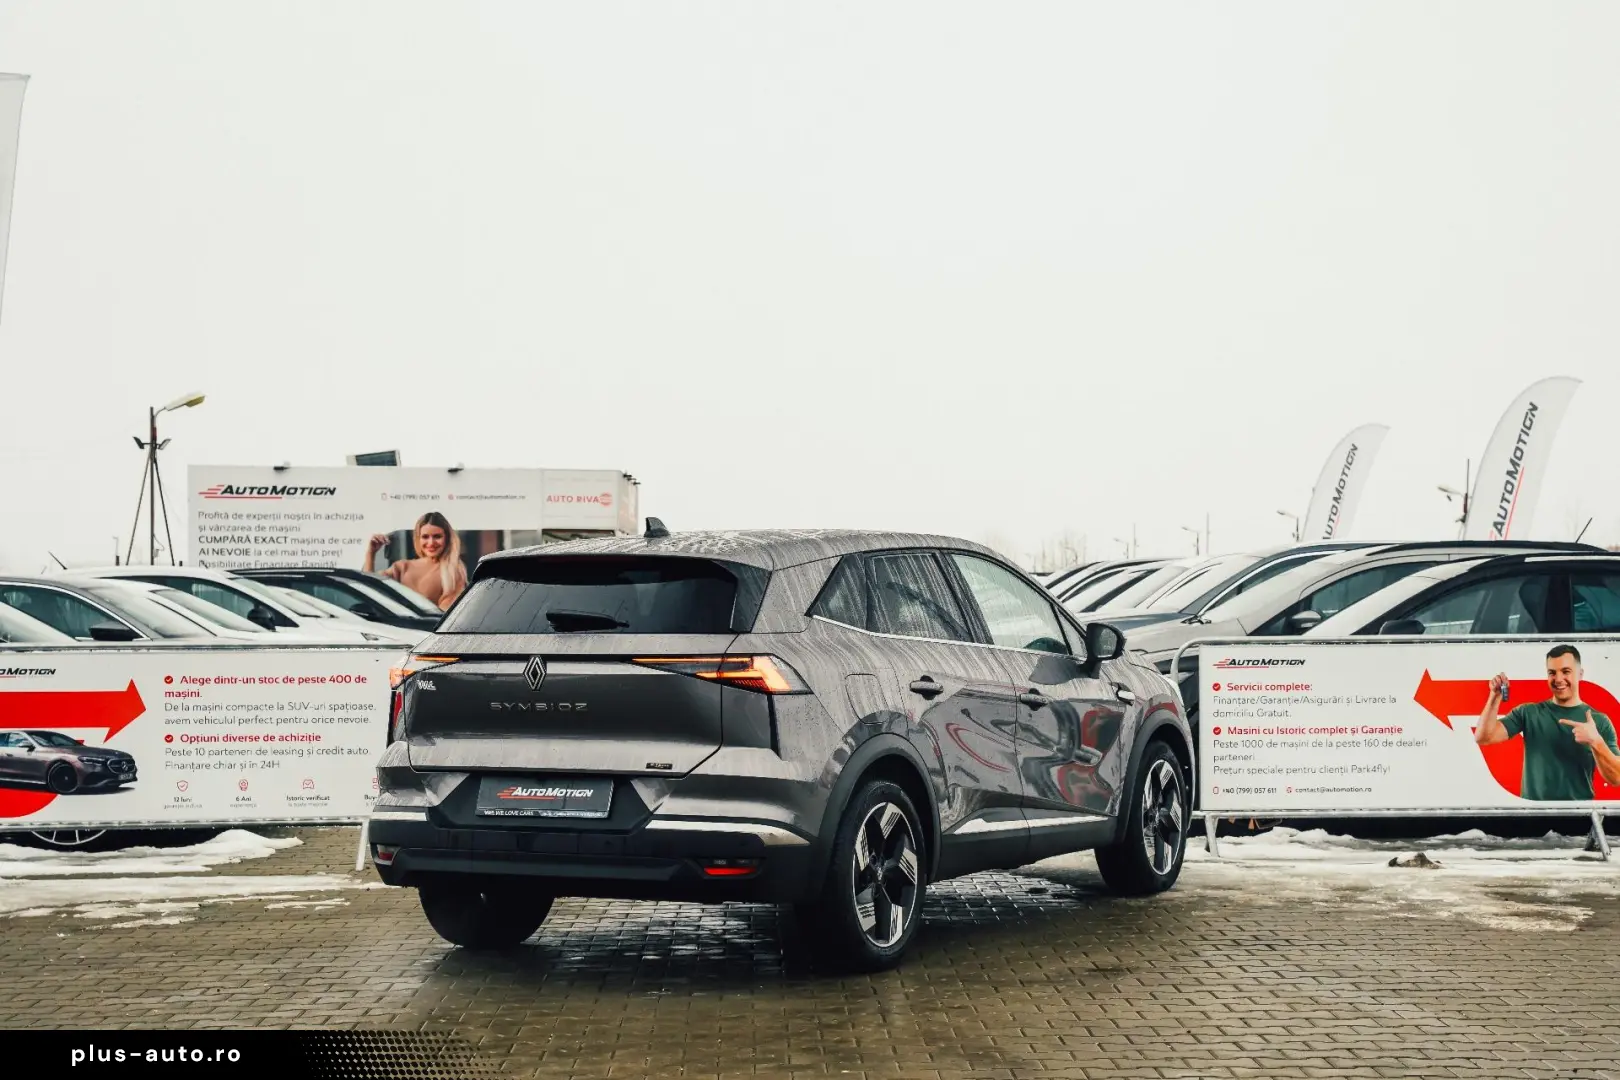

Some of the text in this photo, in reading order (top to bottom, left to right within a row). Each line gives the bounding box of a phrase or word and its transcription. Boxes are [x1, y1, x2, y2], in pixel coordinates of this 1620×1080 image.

[232, 512, 244, 520] de
[254, 524, 267, 532] de
[254, 536, 288, 544] EXACT
[199, 548, 209, 556] AI
[212, 548, 250, 556] NEVOIE
[265, 548, 279, 556] cel
[301, 548, 319, 556] bun
[180, 675, 367, 686] Alege dintr-un stoc de peste 400 de
[1227, 683, 1312, 692] Servicii complete:
[1356, 695, 1386, 703] Livrare
[1389, 695, 1396, 703] la
[165, 702, 178, 711] De
[182, 702, 189, 711] la
[193, 703, 222, 714] mașini
[226, 704, 274, 712] compacte
[277, 702, 284, 711] la
[288, 702, 325, 710] SUV-uri
[1213, 709, 1253, 717] domiciliu
[193, 716, 235, 724] vehiculul
[237, 715, 273, 726] perfect
[276, 716, 308, 726] pentru
[311, 715, 334, 723] orice
[1277, 726, 1306, 734] Istoric
[1309, 726, 1348, 736] complet
[1361, 725, 1402, 735] Garanție
[180, 732, 321, 744] Opțiuni diverse de achiziție
[1214, 738, 1427, 750] Peste 1000 de mașini de la peste 160 de dealeri
[165, 748, 192, 756] Peste
[195, 748, 205, 756] 10
[208, 748, 252, 757] parteneri
[255, 747, 268, 756] de
[271, 747, 303, 757] leasing
[316, 746, 344, 755] credit
[166, 761, 210, 772] Finanțare
[213, 761, 236, 769] chiar
[261, 760, 279, 769] 24H
[1214, 766, 1244, 776] Prețuri
[1247, 766, 1283, 775] speciale
[1286, 767, 1316, 775] pentru
[1319, 765, 1348, 776] clienții
